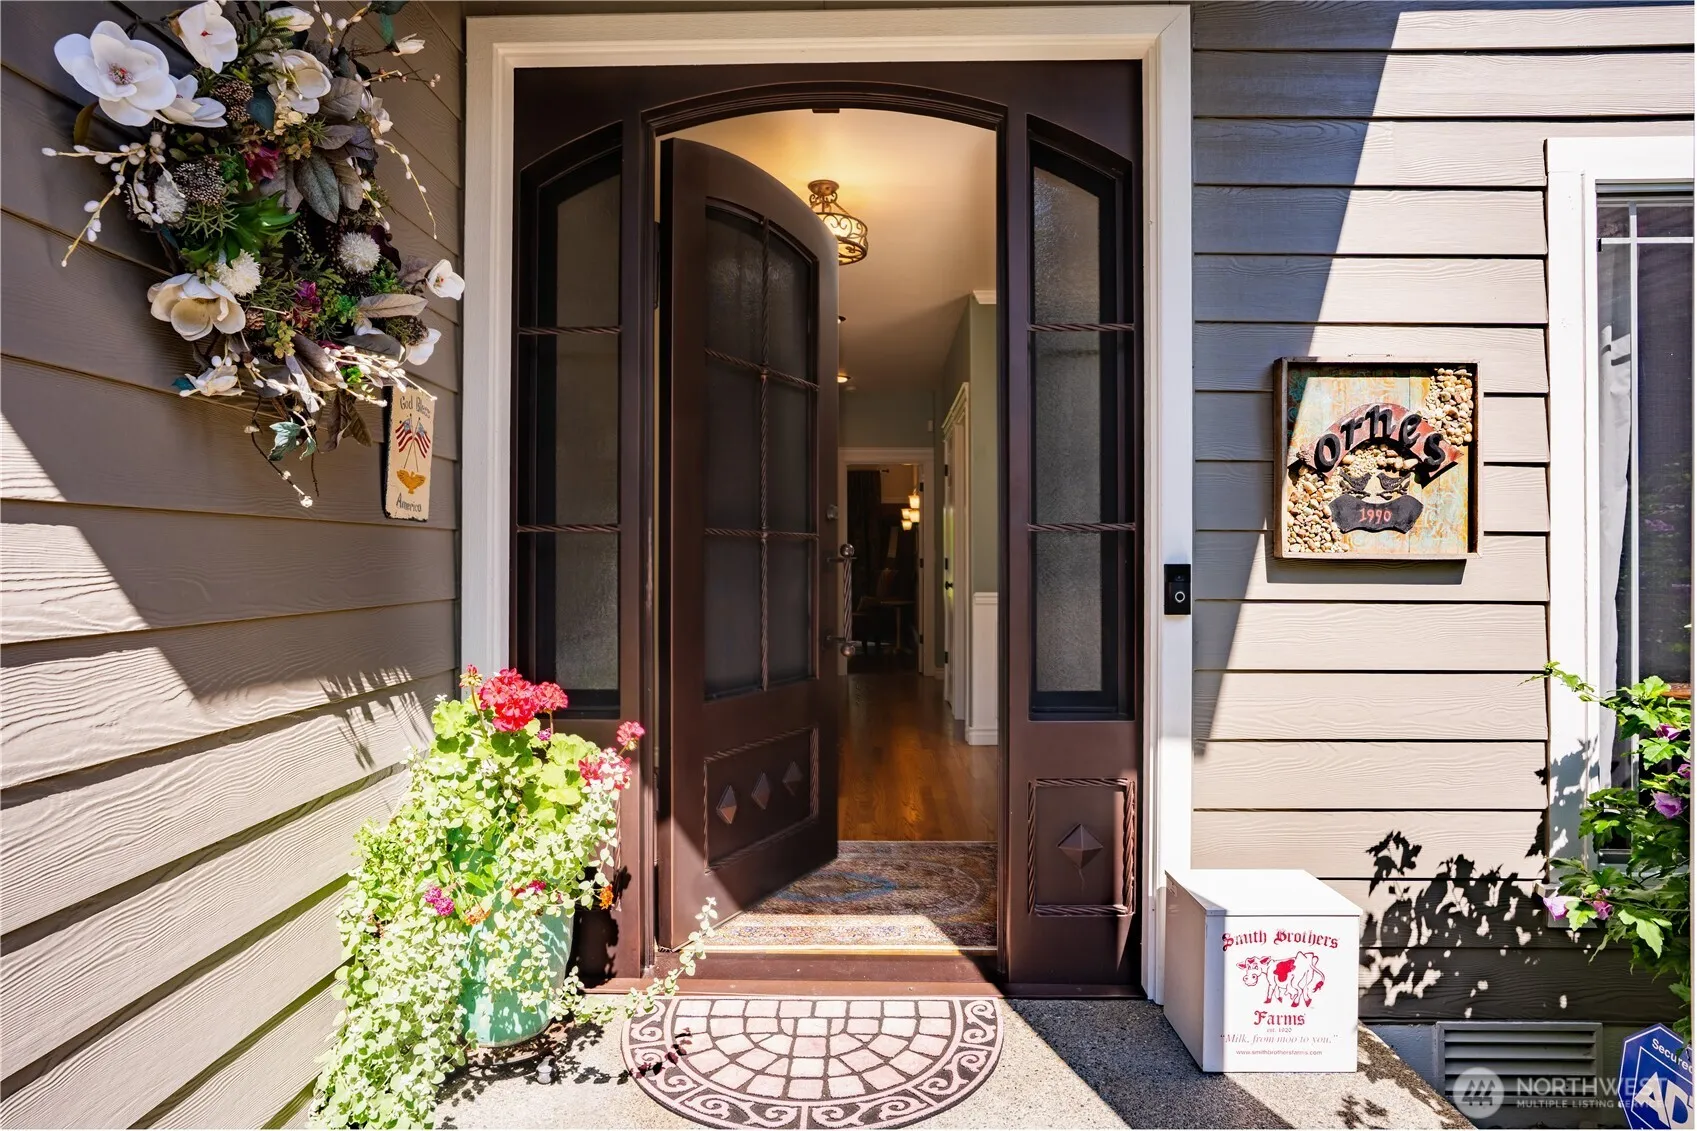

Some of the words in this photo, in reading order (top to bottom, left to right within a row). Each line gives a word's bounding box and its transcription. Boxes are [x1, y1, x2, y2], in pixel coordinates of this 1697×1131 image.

[400, 395, 413, 410] God
[395, 491, 422, 512] America
[1359, 508, 1392, 524] 1990
[1221, 930, 1267, 952] Smith
[1273, 929, 1338, 949] Brothers
[1253, 1010, 1306, 1026] Farms
[1251, 1034, 1274, 1045] from
[1299, 1035, 1310, 1043] to
